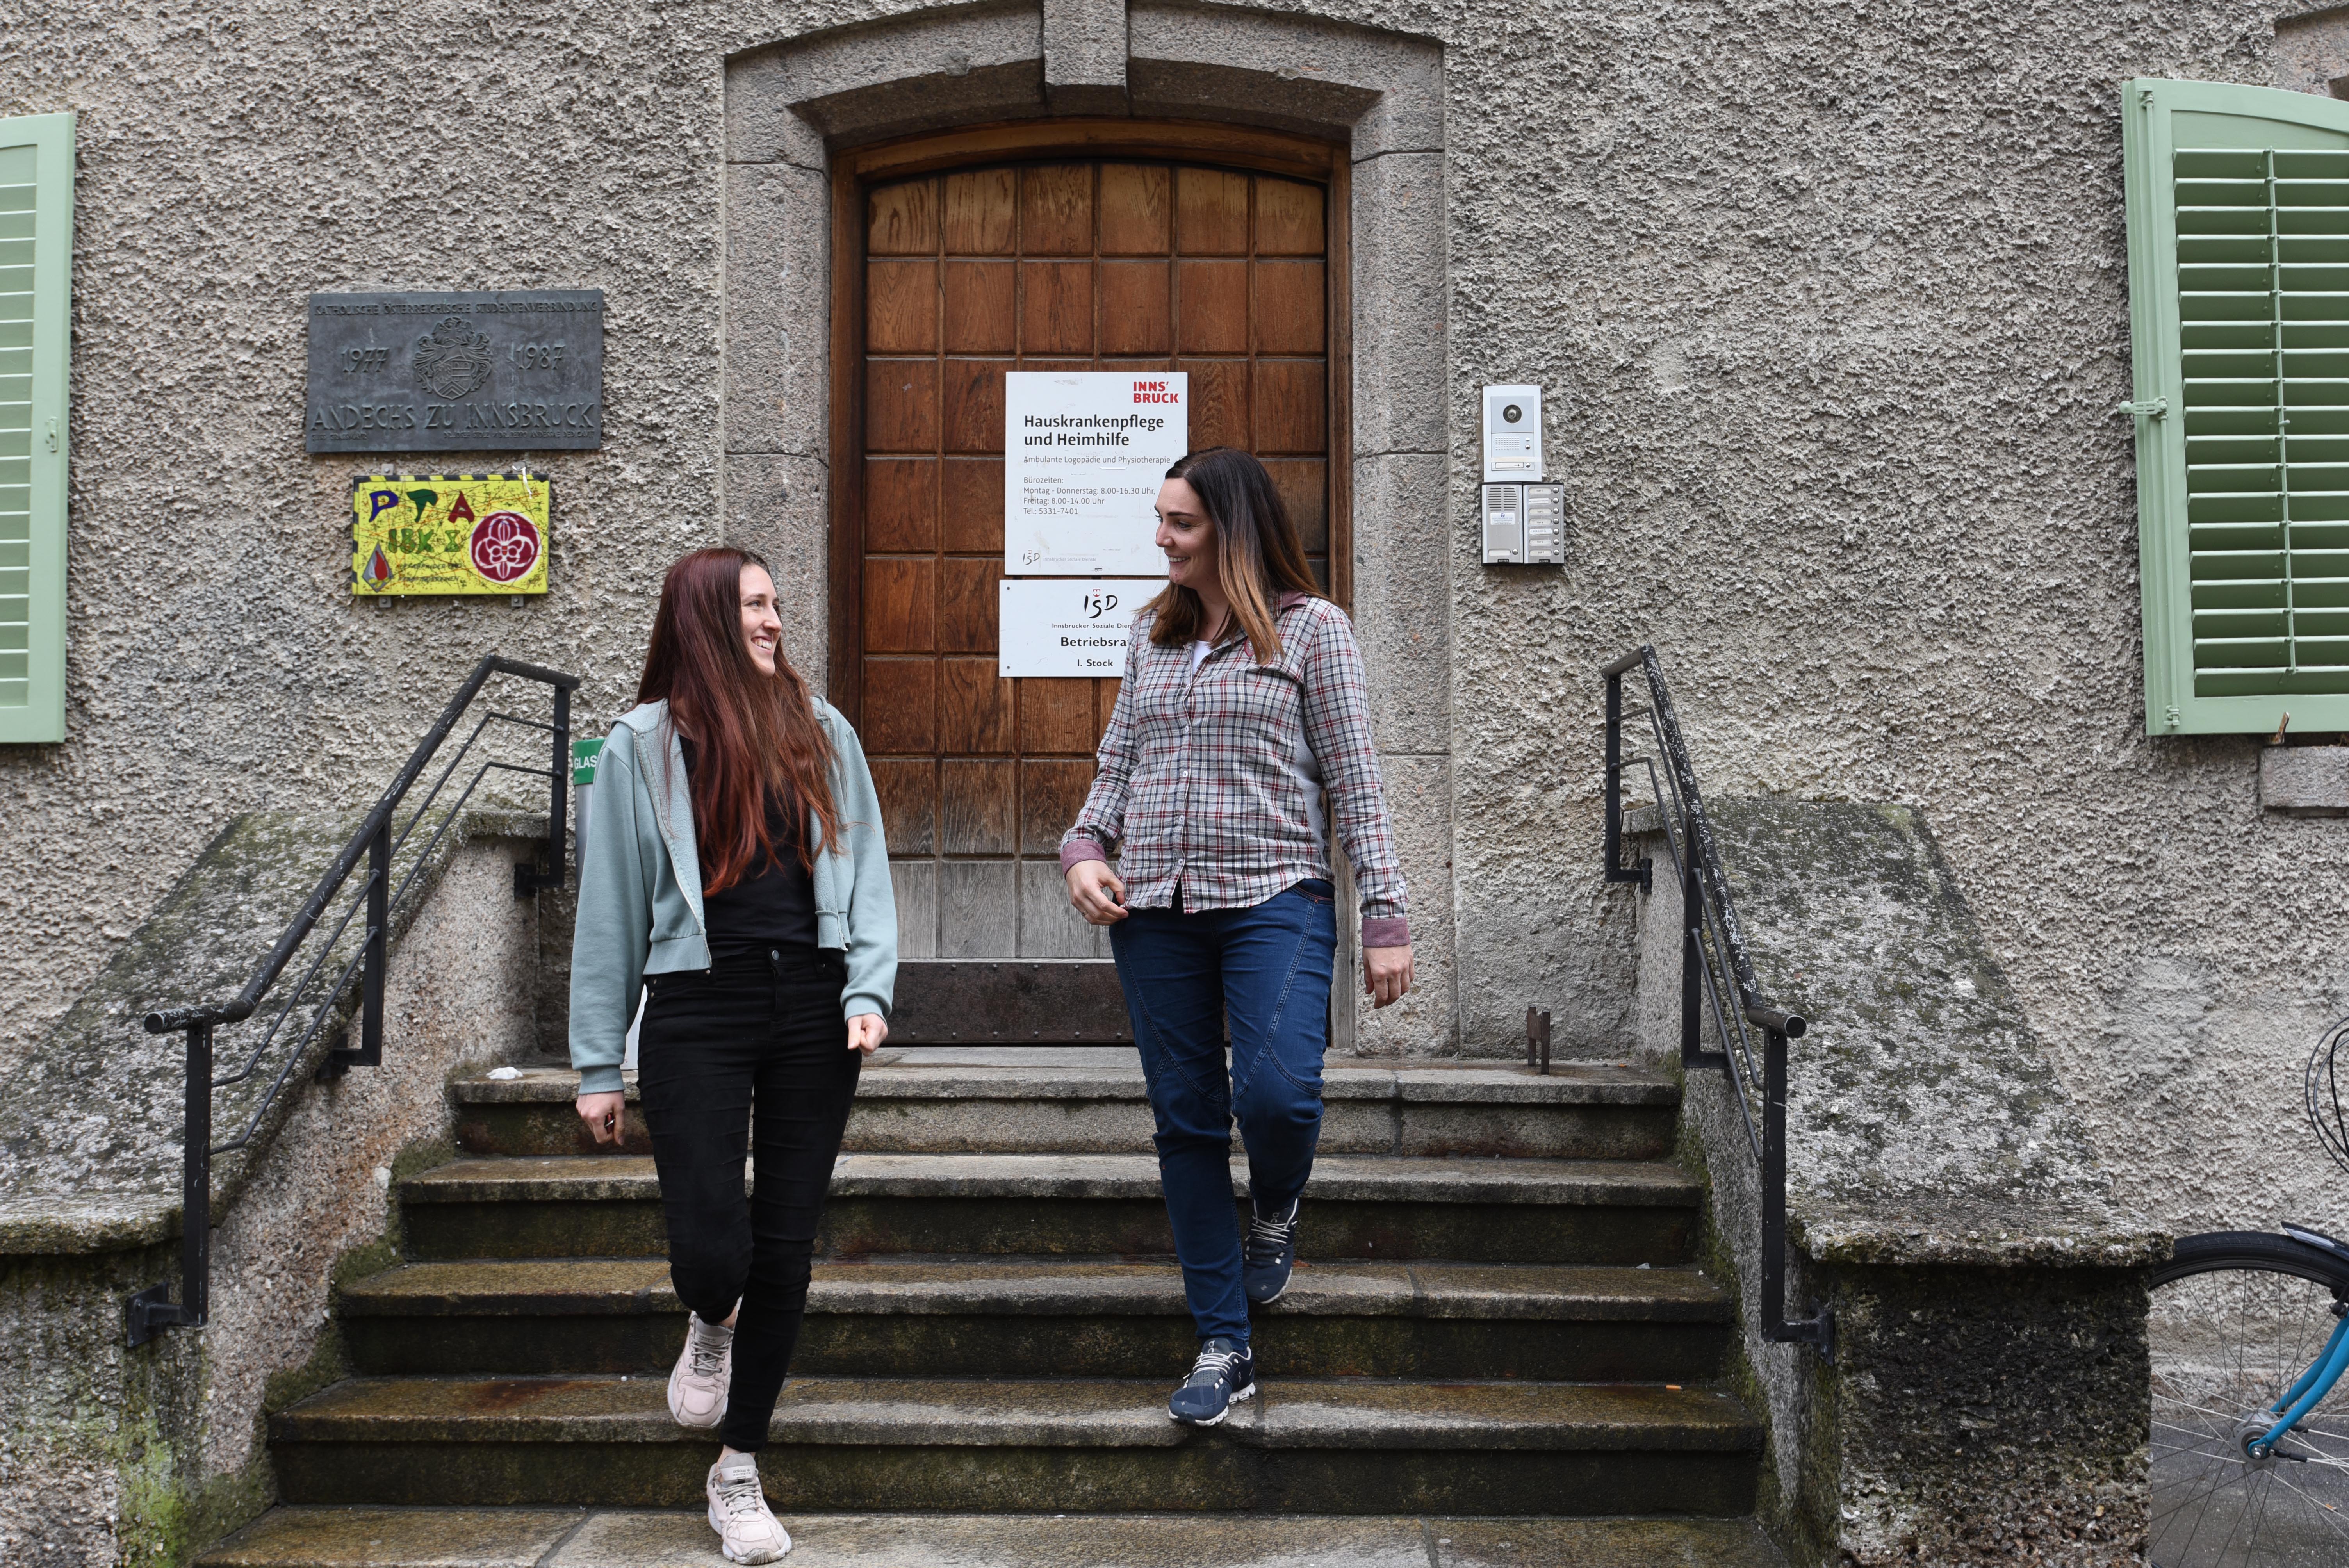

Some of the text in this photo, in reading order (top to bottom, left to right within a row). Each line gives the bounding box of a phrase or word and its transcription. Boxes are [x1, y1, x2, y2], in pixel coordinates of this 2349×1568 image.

[314, 301, 597, 315] KATHOLISCHE ÖSTERREICHISCHE STUDENTENVERBINDUNG
[340, 347, 390, 373] 1977
[516, 343, 566, 370] 1987
[1133, 381, 1169, 392] INNS'
[1133, 393, 1179, 404] BRUCK
[311, 402, 595, 430] ANDECHS ZU INNSBRUCK
[1025, 414, 1164, 431] Hauskrankenpflege
[1025, 432, 1129, 446] und Heimhilfe
[1064, 456, 1101, 465] Logopädie
[1118, 456, 1171, 465] Physiotherapie
[1024, 487, 1050, 495] Montag
[1057, 487, 1099, 496] Donnerstag:
[1141, 487, 1155, 495] Uhr,
[369, 489, 475, 523] PTA
[1023, 497, 1050, 506] Freitag:
[1023, 553, 1040, 565] ISD
[1084, 595, 1118, 619] ISD
[1086, 659, 1113, 667] Stock
[574, 755, 597, 769] GLAS
